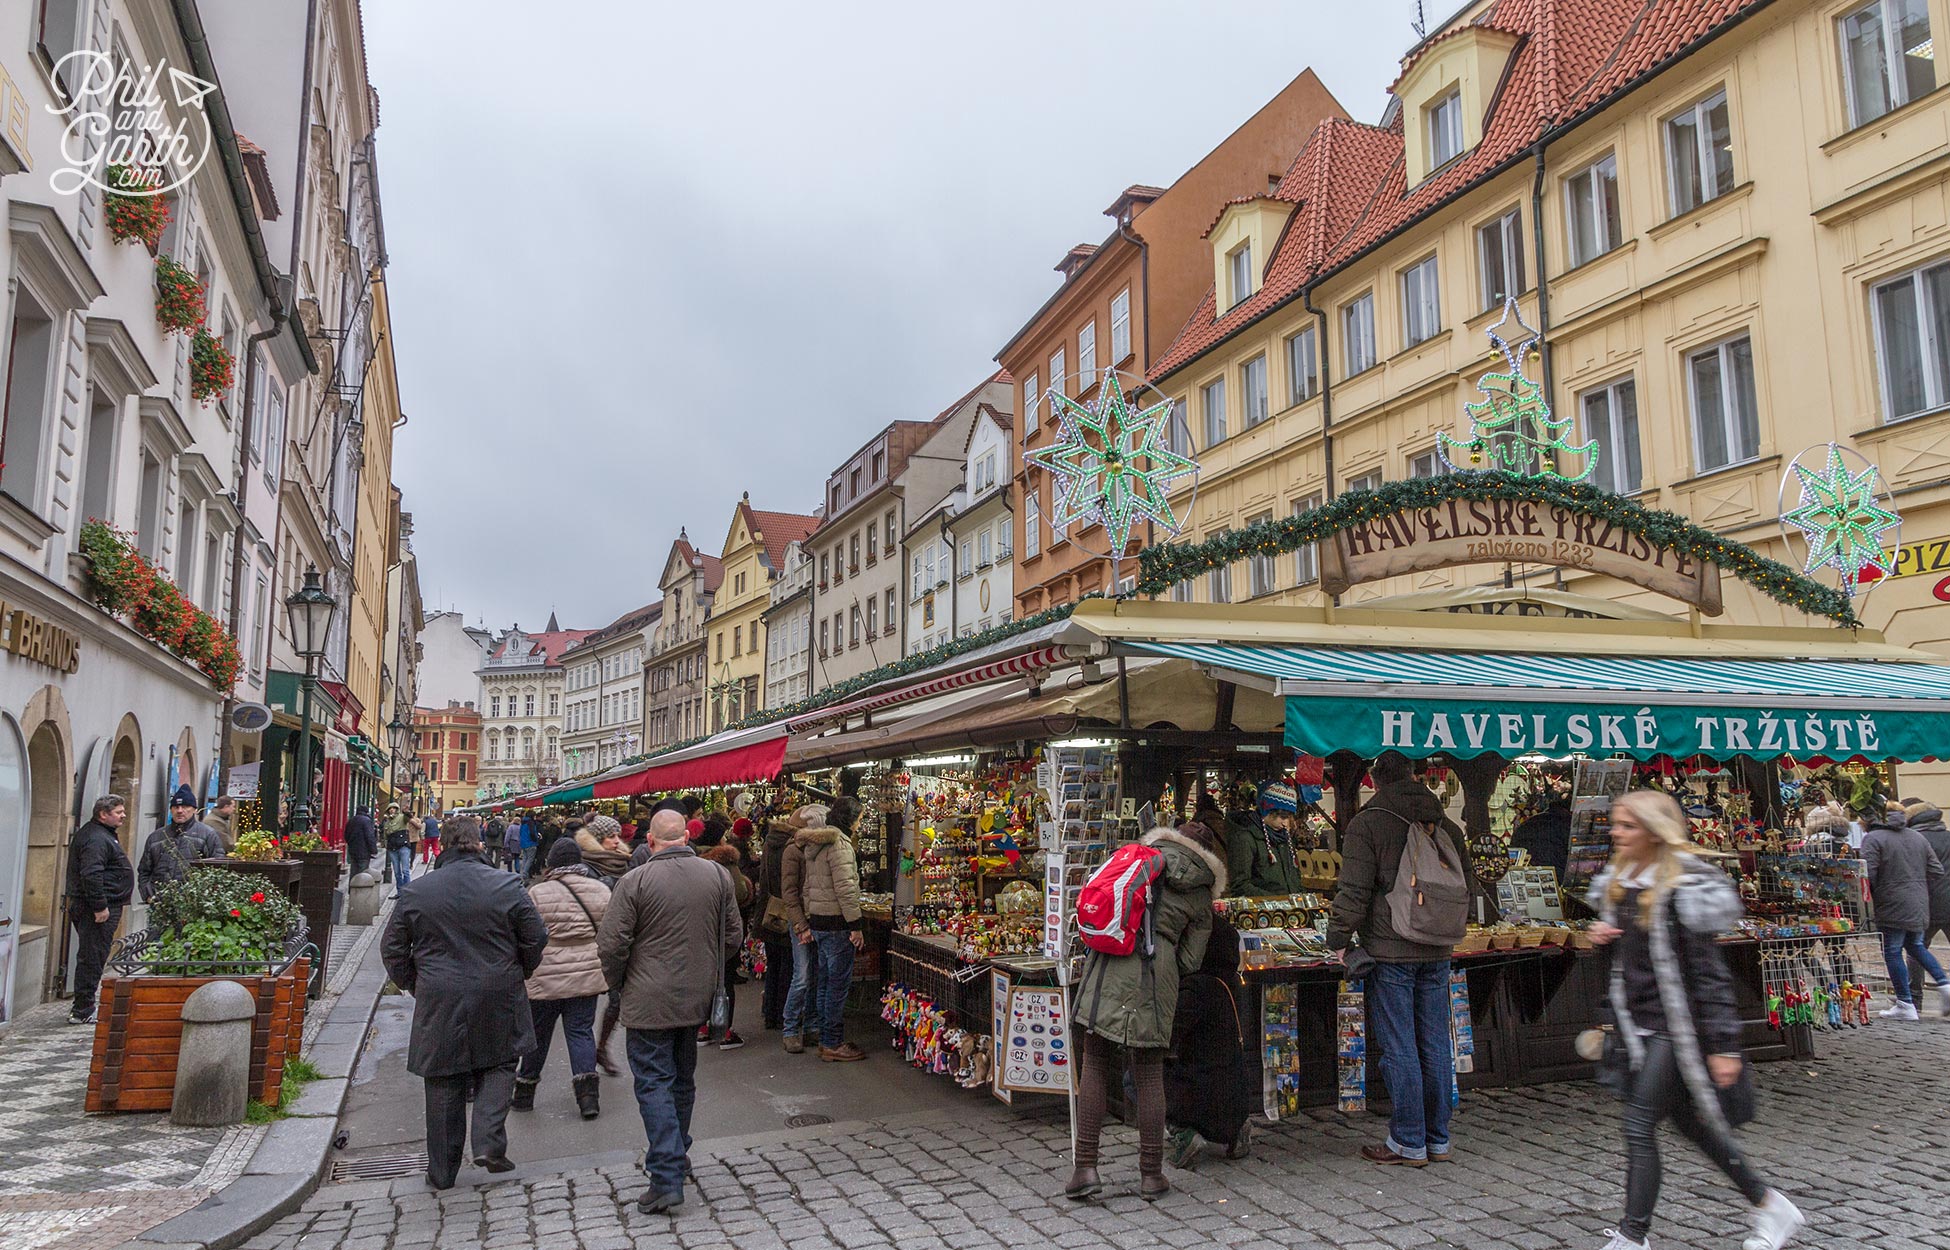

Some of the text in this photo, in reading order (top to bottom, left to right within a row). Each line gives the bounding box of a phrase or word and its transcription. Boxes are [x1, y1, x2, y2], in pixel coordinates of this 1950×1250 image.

[1466, 539, 1594, 567] založeno 1232
[14, 610, 81, 675] BRANDS
[1381, 706, 1880, 752] HAVELSKÉ TRŽIŠTĚ
[1271, 786, 1295, 798] adidas
[1031, 994, 1042, 1004] CZ
[1014, 1051, 1025, 1060] CZ
[1009, 1069, 1026, 1081] CZ
[1033, 1072, 1046, 1081] CZ
